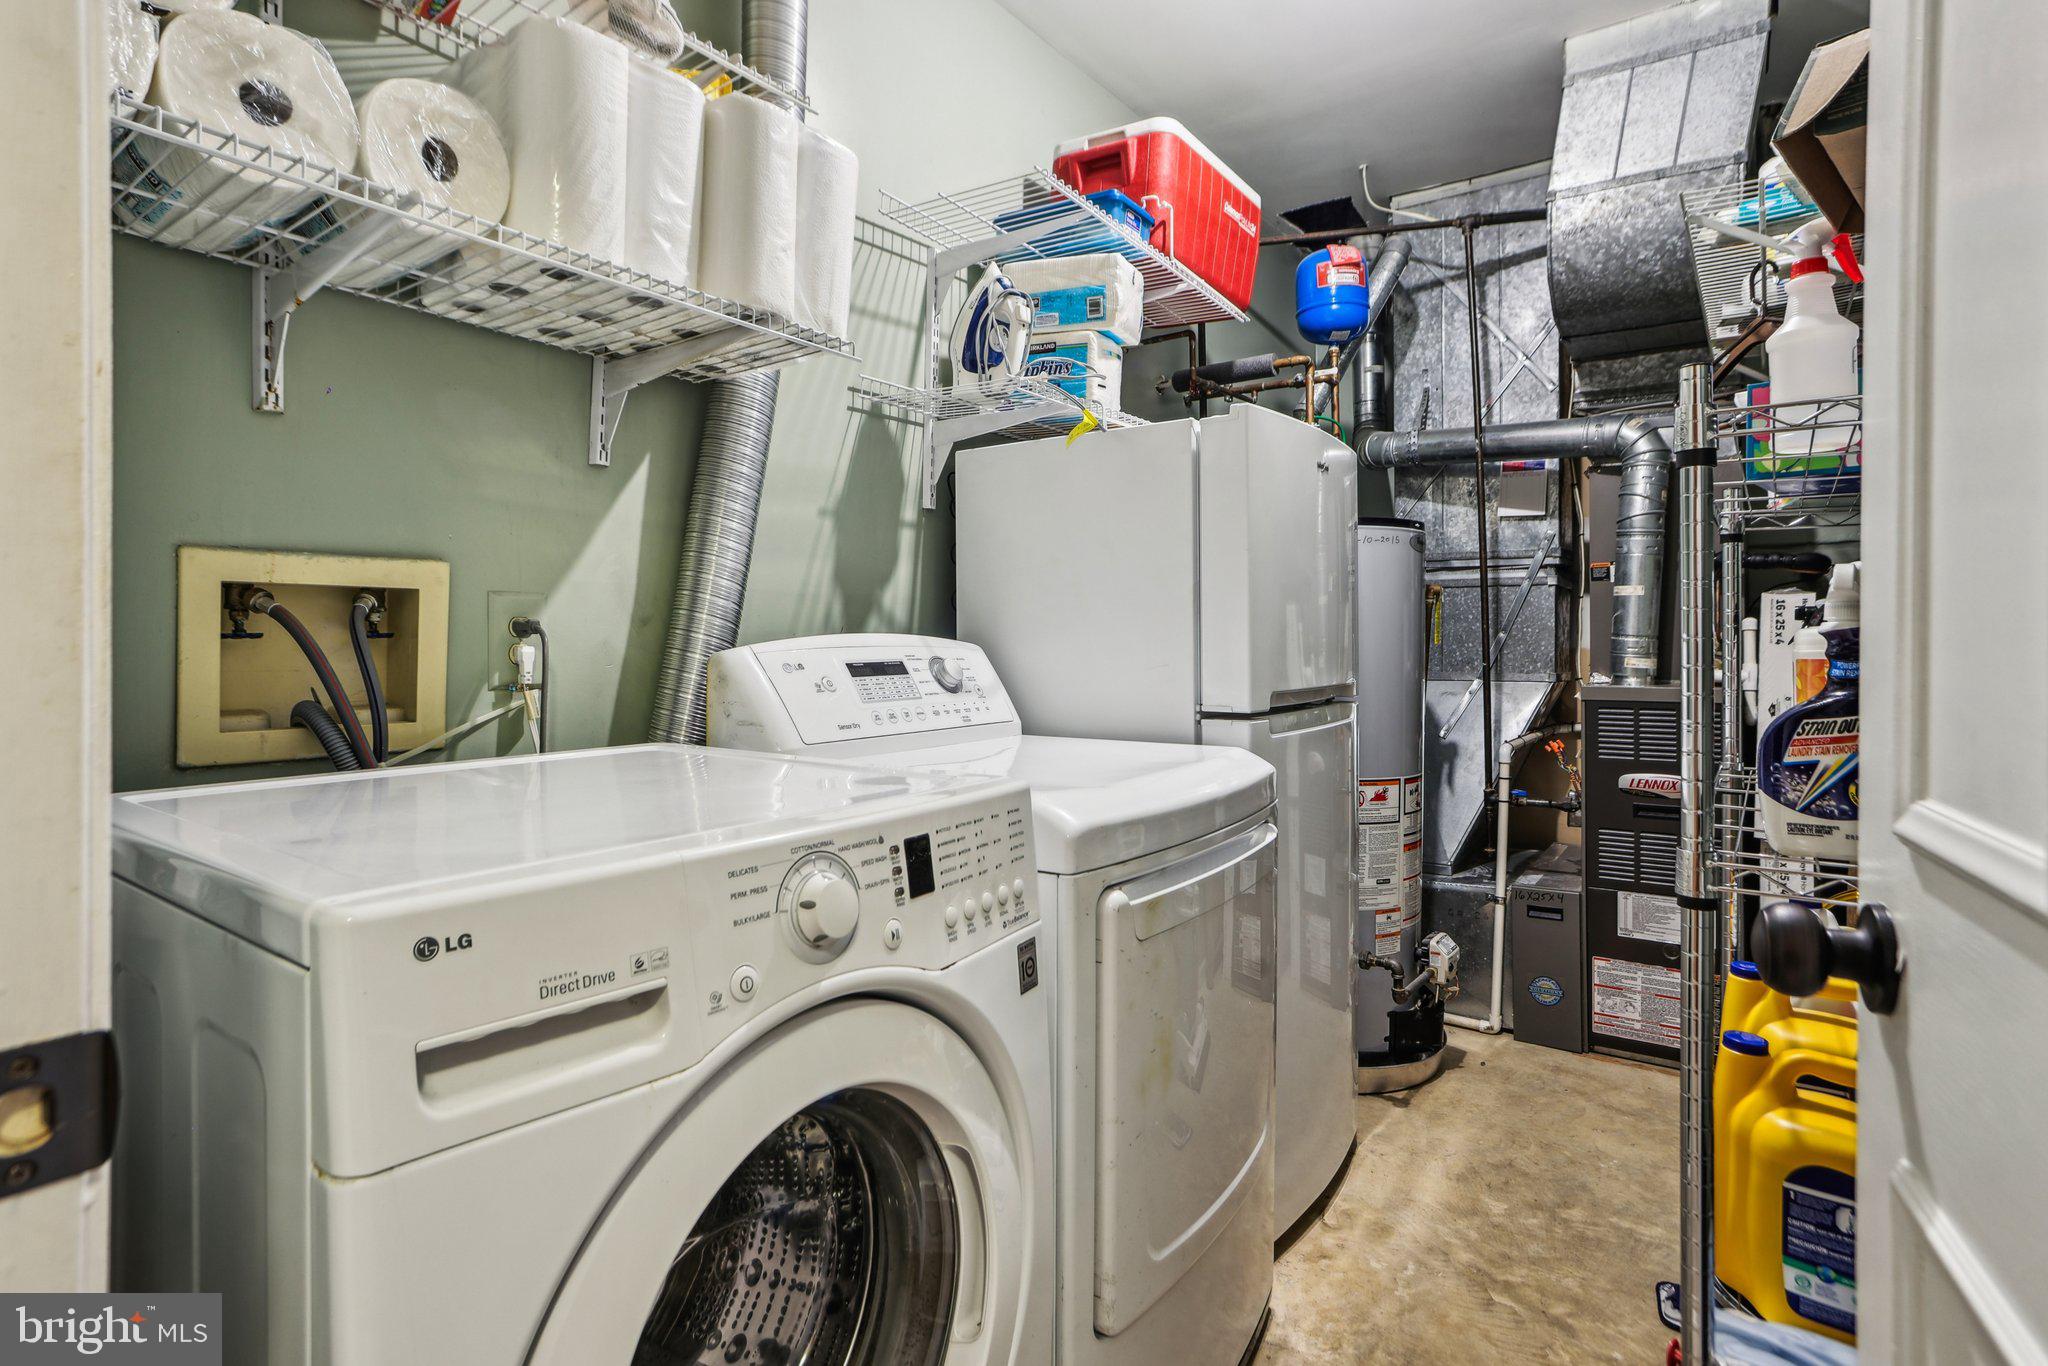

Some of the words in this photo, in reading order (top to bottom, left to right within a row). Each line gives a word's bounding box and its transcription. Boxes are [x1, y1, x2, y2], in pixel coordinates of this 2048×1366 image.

[1775, 599, 1786, 611] 16
[1775, 619, 1786, 632] 25
[1796, 720, 1837, 737] STAIN
[1838, 718, 1859, 735] OU
[1787, 747, 1813, 758] LAUNDRY
[1814, 746, 1831, 756] STAIN
[1629, 778, 1680, 791] LENNOX
[727, 865, 760, 879] DELICATES
[749, 885, 768, 896] PRESS
[445, 933, 473, 953] LG
[539, 971, 579, 984] INVERTER
[539, 978, 581, 1000] Direct
[583, 970, 616, 990] Drive
